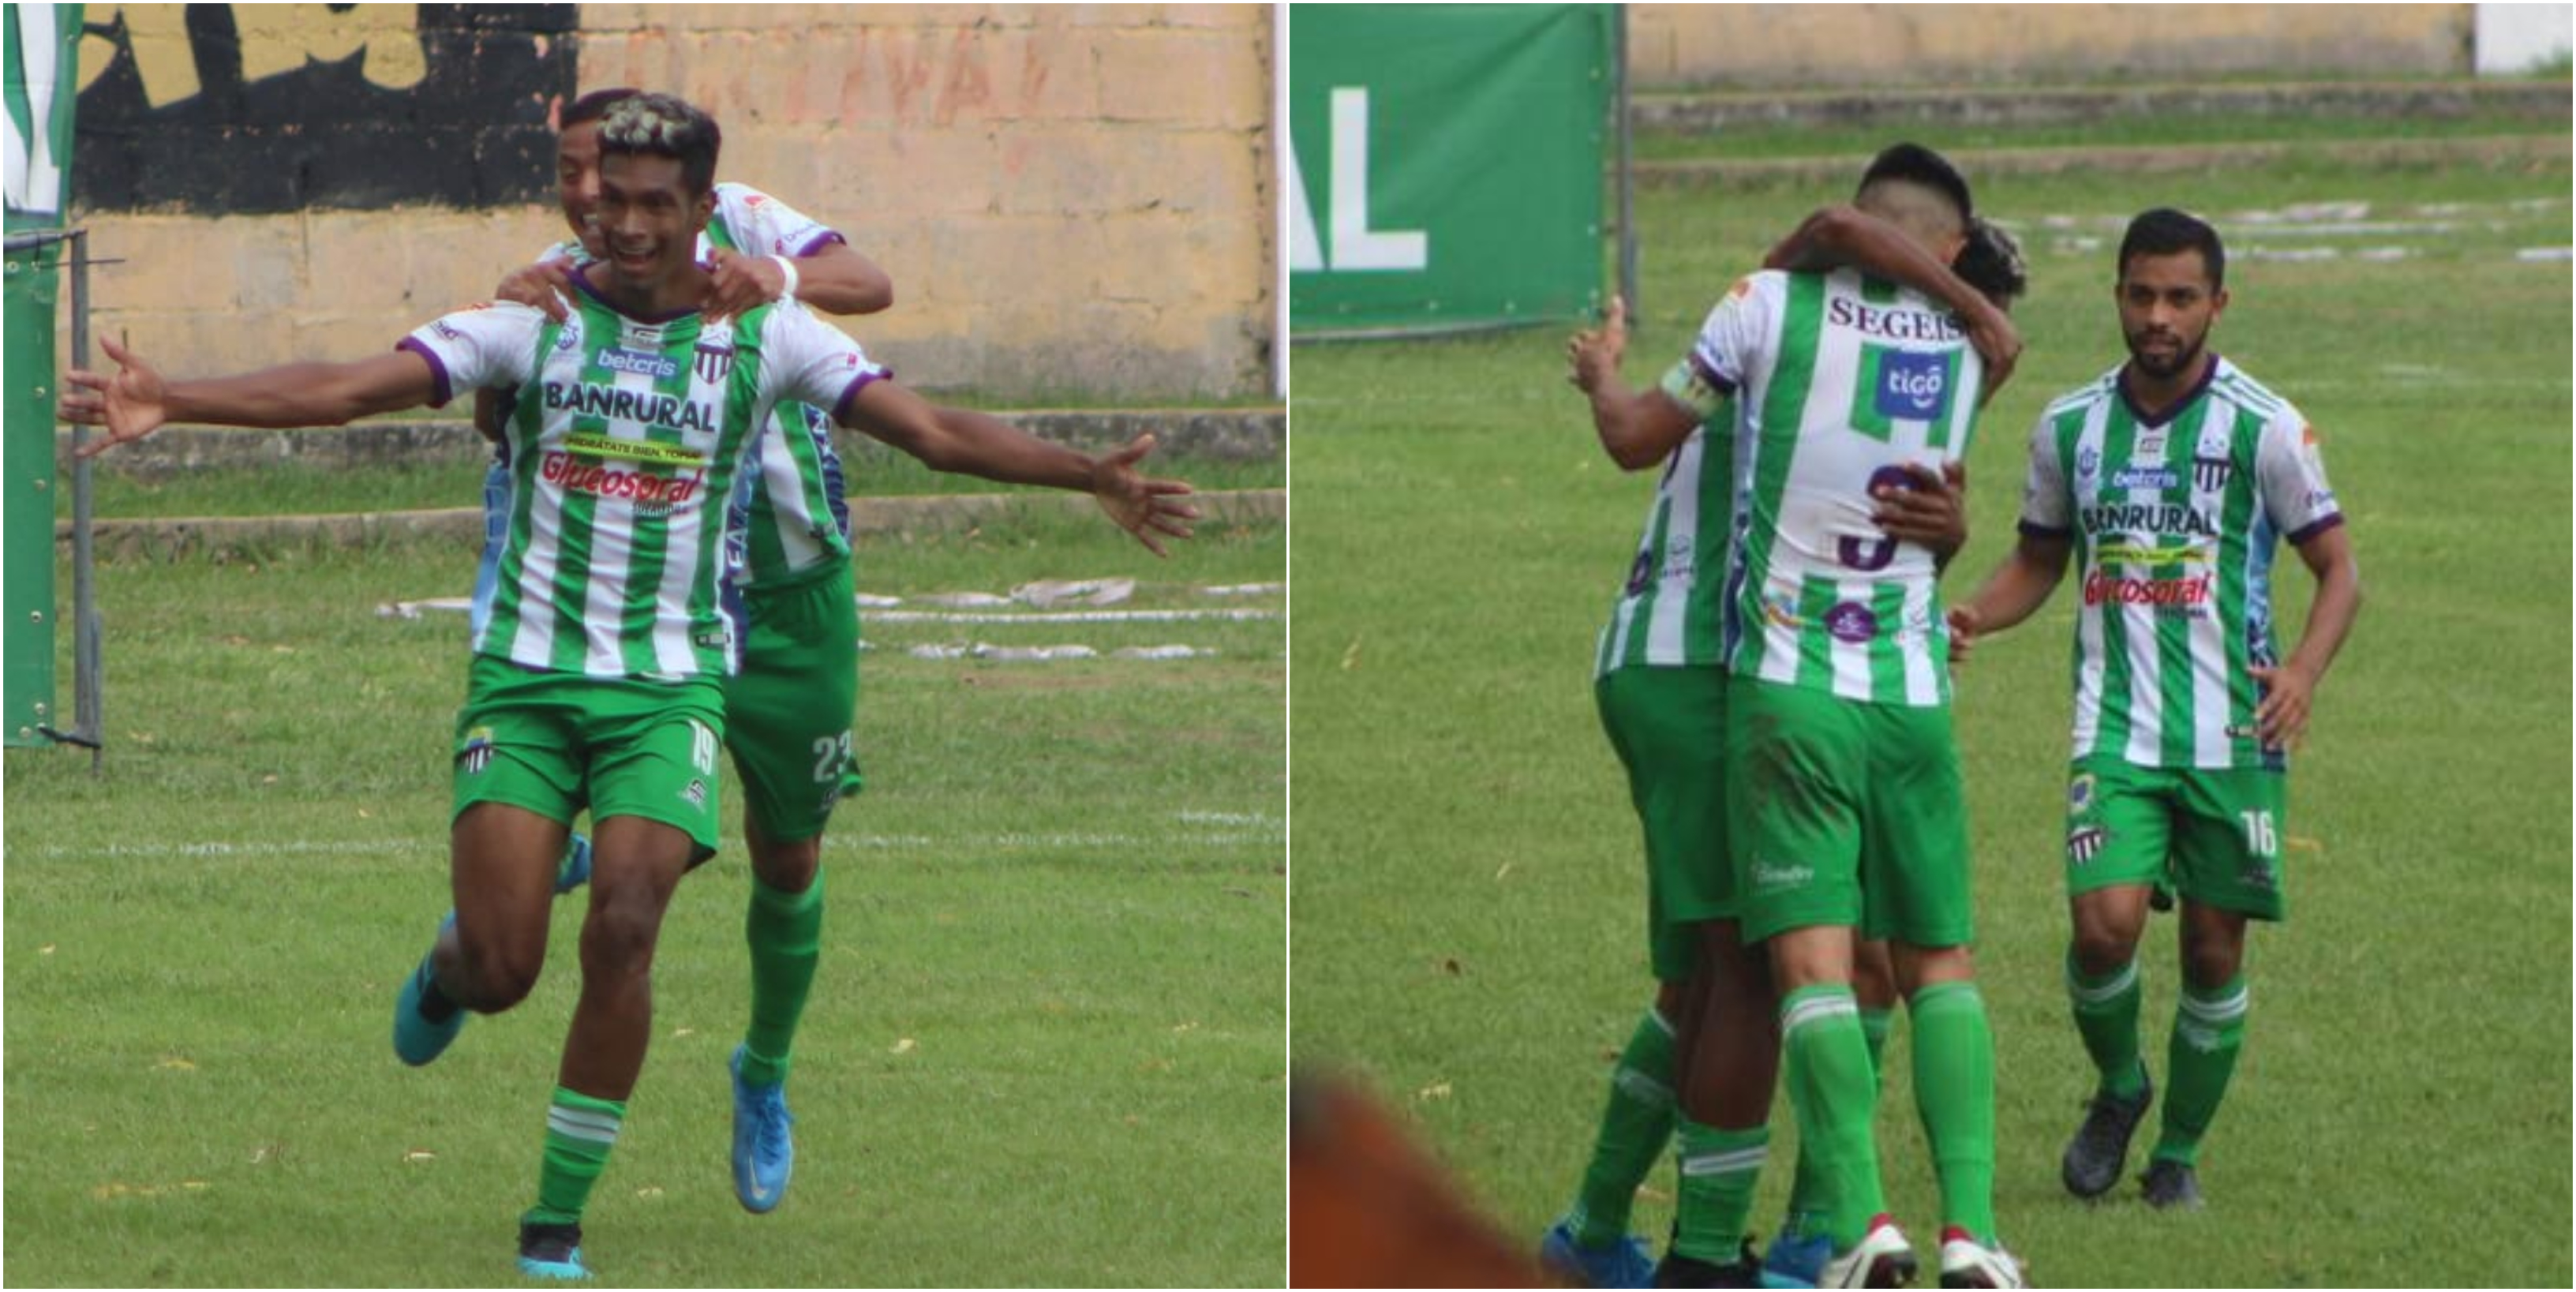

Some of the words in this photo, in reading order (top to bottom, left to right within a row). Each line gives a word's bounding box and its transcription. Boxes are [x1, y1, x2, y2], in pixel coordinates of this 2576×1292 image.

[597, 348, 676, 376] betcris
[545, 381, 716, 433] BANRURAL
[541, 450, 704, 502] Glucosoral
[688, 718, 714, 776] 19
[2239, 809, 2277, 858] 16
